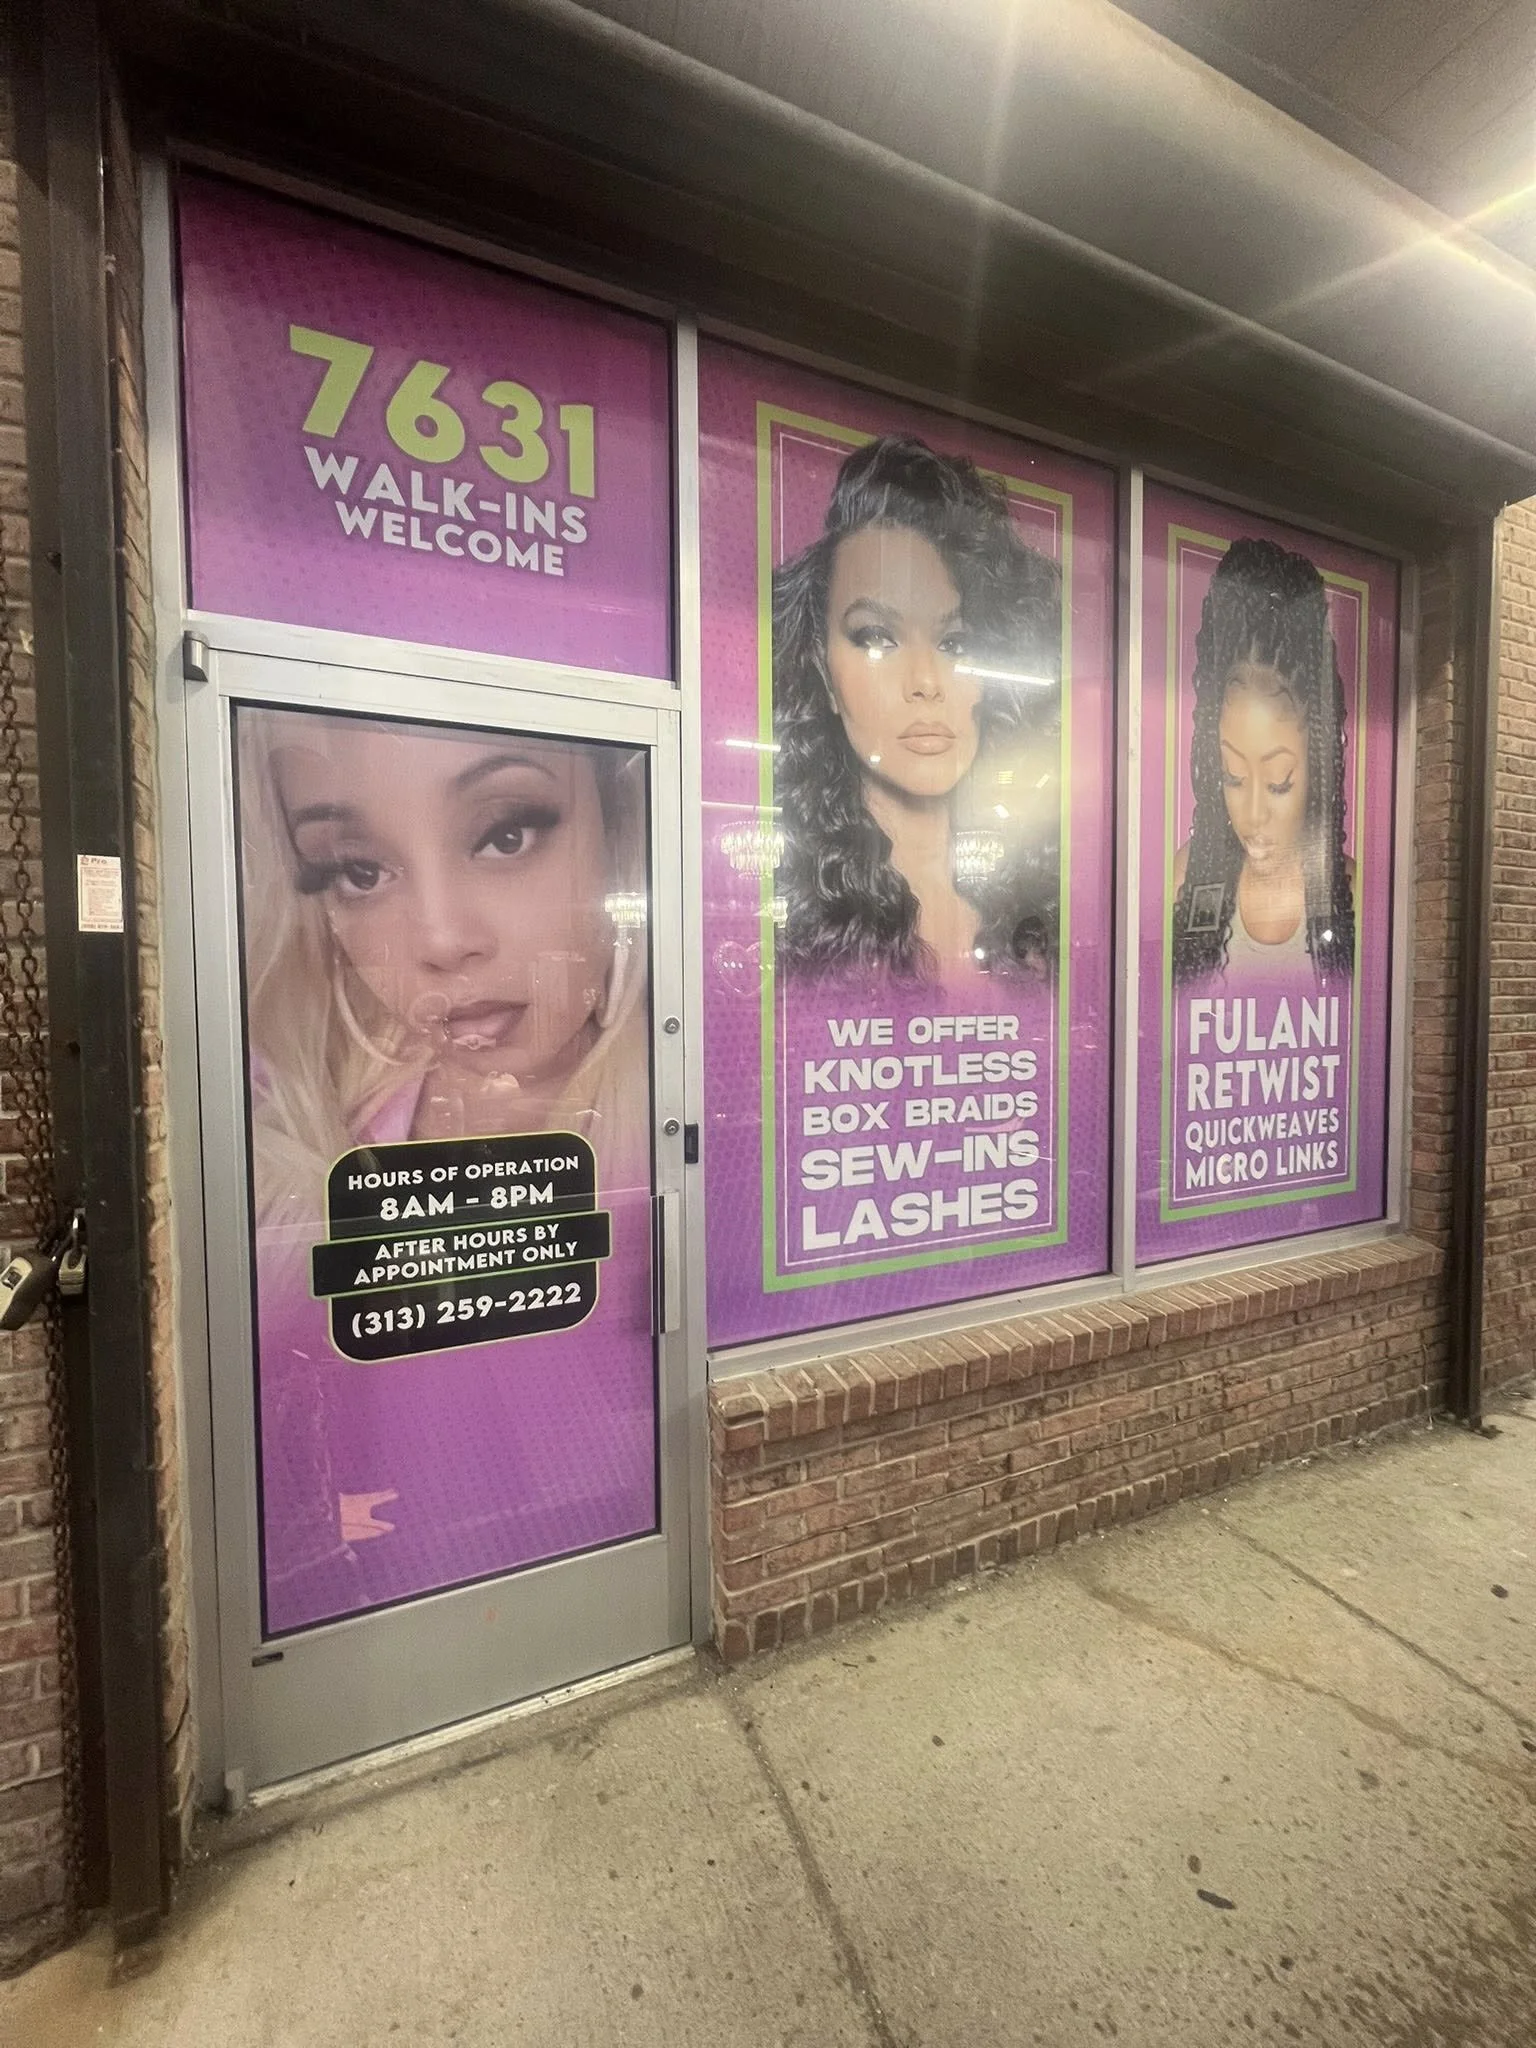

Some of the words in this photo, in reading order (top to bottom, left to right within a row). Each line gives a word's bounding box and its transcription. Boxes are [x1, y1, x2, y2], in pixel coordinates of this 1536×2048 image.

[290, 324, 595, 498] 7631
[303, 445, 588, 544] WALK-INS
[335, 500, 565, 577] WELCOME
[827, 1018, 894, 1048] WE
[907, 1015, 1019, 1045] OFFER
[1189, 996, 1340, 1054] FULANI
[804, 1050, 1037, 1095] KNOTLESS
[1187, 1054, 1341, 1112] RETWIST
[803, 1101, 890, 1137] BOX
[905, 1091, 1039, 1127] BRAIDS
[1185, 1107, 1339, 1153] QUICKWEAVES
[348, 1169, 423, 1191] HOURS
[430, 1166, 458, 1183] OF
[465, 1155, 580, 1178] OPERATION
[800, 1130, 1040, 1191] SEW-INS
[1185, 1148, 1268, 1190] MICRO
[1276, 1140, 1339, 1176] LINKS
[379, 1191, 454, 1221] 8AM
[490, 1182, 554, 1209] 8PM
[802, 1178, 1039, 1251] LASHES
[353, 1249, 516, 1286] APPOINTMENT
[522, 1241, 578, 1261] ONLY
[374, 1237, 446, 1261] AFTER
[453, 1227, 528, 1251] HOURS
[534, 1223, 560, 1240] BY
[351, 1304, 426, 1339] (313)
[436, 1282, 582, 1324] 259-2222
